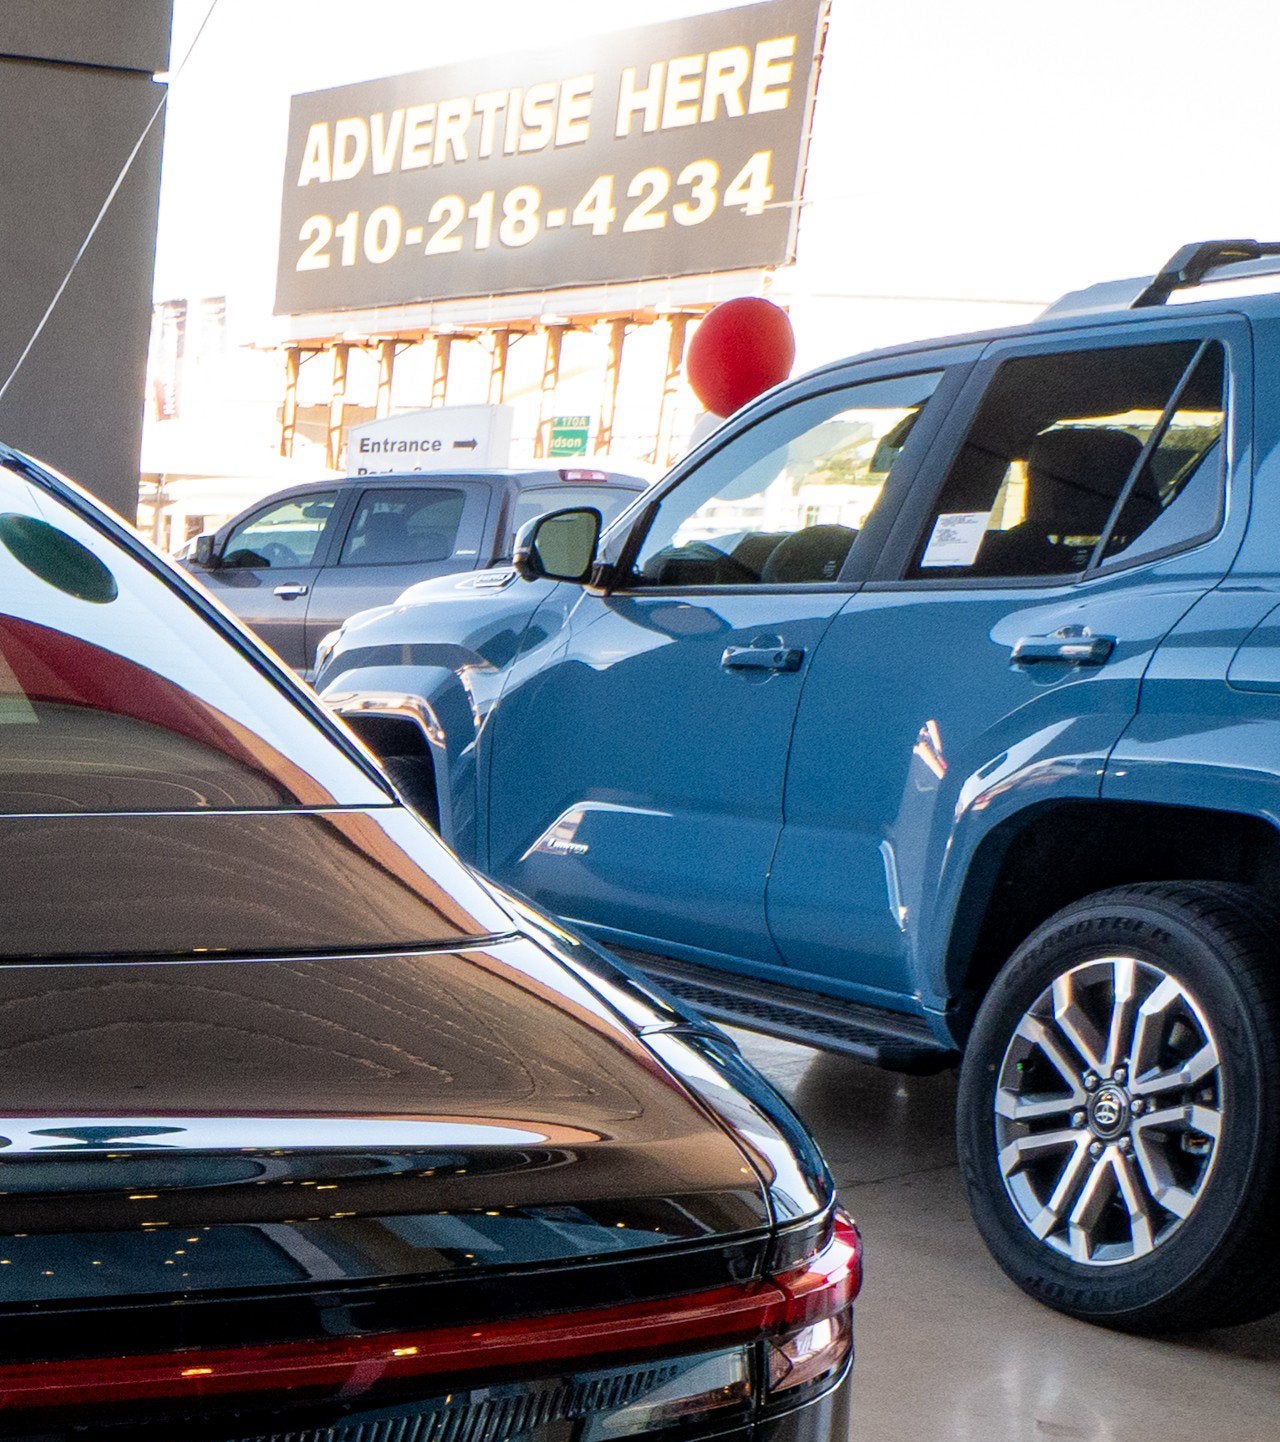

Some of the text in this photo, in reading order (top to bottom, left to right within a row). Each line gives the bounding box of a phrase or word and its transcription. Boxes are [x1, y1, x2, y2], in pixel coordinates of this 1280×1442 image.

[297, 35, 798, 187] ADVERTISE HERE
[296, 150, 775, 272] 210-218-4234
[359, 437, 442, 454] Entrance
